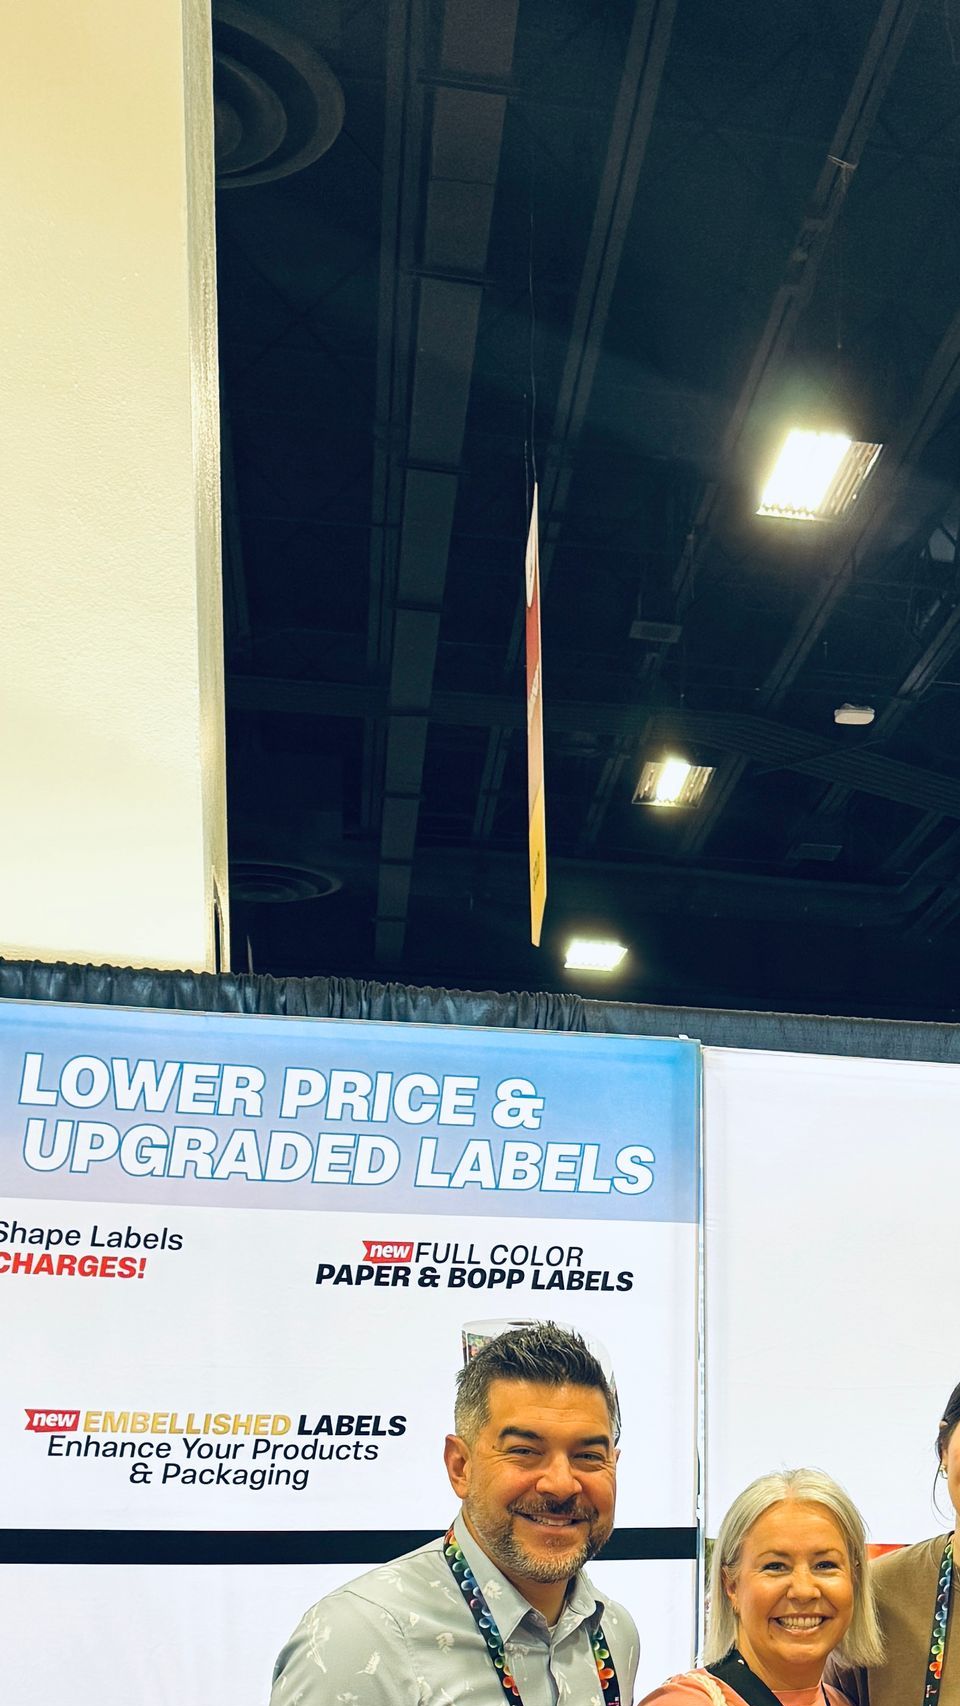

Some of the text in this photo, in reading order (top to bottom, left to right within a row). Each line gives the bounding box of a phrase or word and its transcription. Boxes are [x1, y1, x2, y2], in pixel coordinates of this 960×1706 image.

[19, 1052, 545, 1130] LOWER PRICE &
[22, 1118, 655, 1195] UPGRADED LABELS
[0, 1220, 184, 1251] Shape Labels
[0, 1252, 147, 1279] CHARGES!
[370, 1242, 584, 1267] new FULL COLOR
[316, 1263, 635, 1292] PAPER & BOPP LABELS
[32, 1411, 407, 1436] new EMBELLISHED LABELS
[47, 1435, 379, 1461] Enhance Your Products
[129, 1462, 310, 1491] & Packaging
